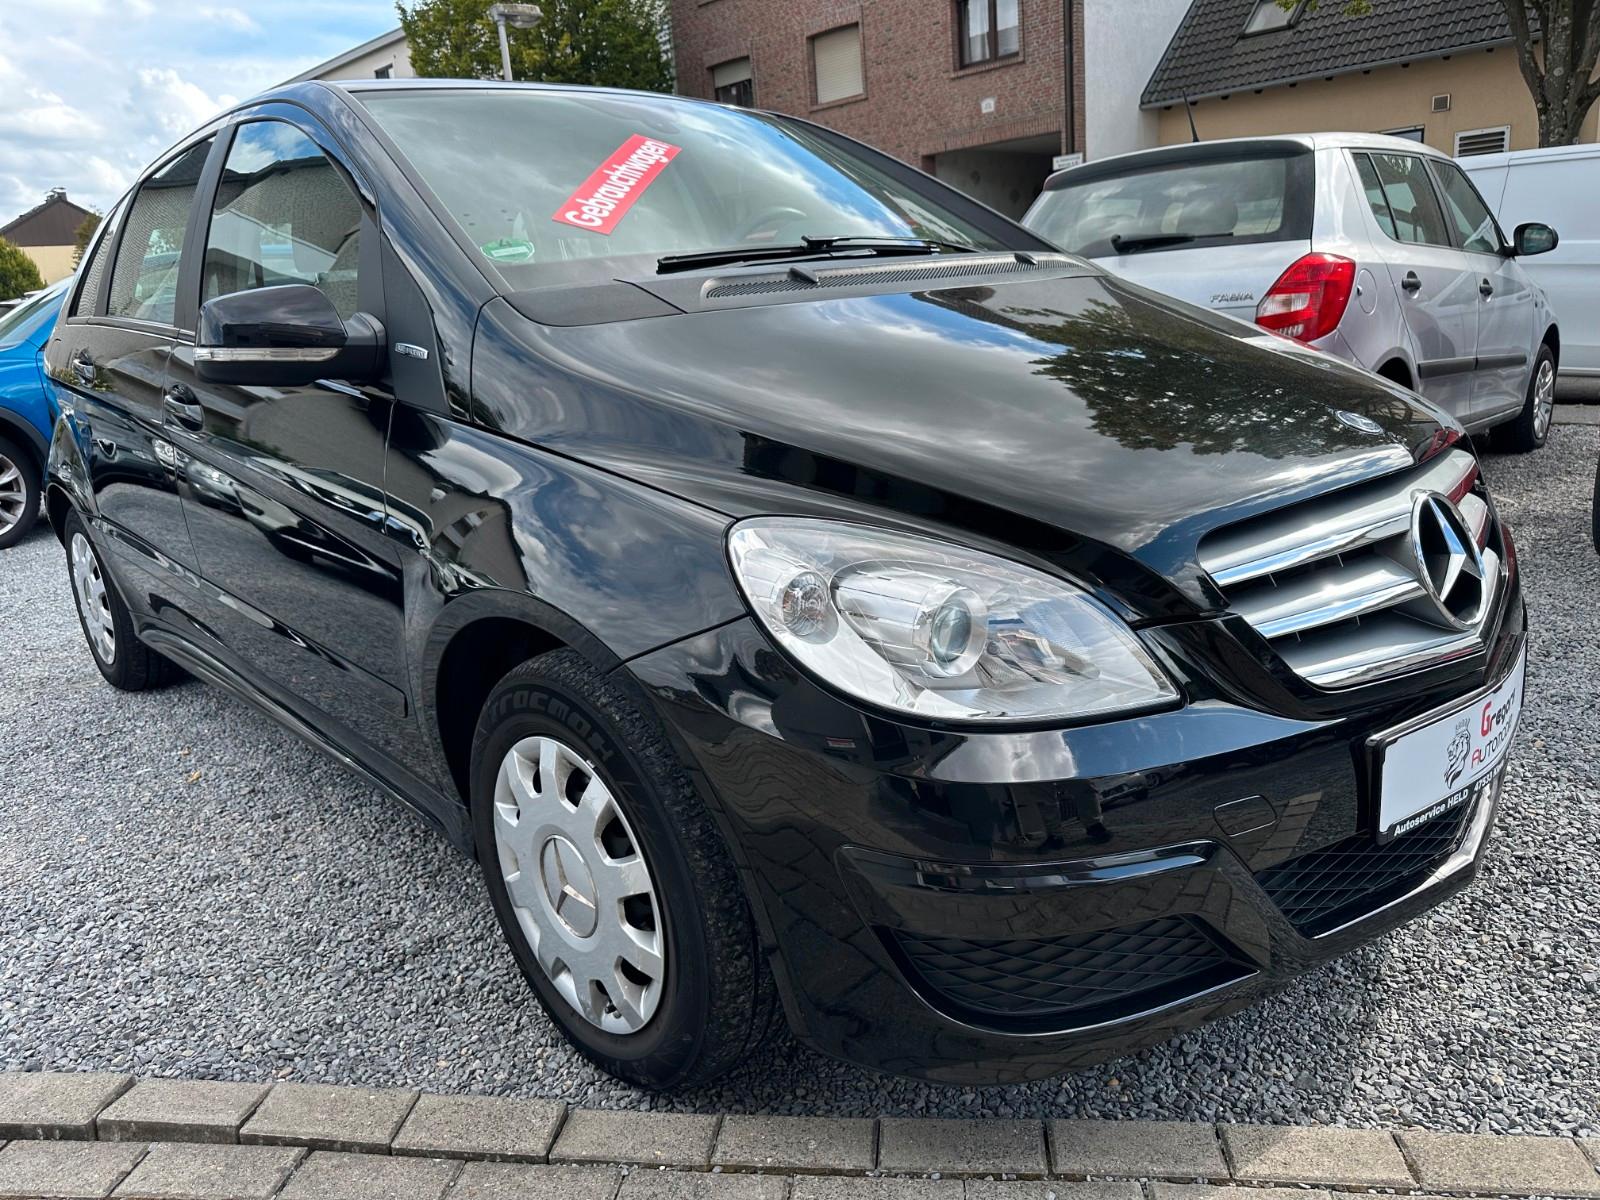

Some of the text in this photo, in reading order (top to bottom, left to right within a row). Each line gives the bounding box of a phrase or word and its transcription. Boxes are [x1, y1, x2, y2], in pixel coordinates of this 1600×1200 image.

[564, 140, 671, 227] Gebrauchtwagen
[1210, 292, 1254, 303] FABIA
[1393, 803, 1446, 836] Autoservice
[1447, 788, 1469, 808] HELD
